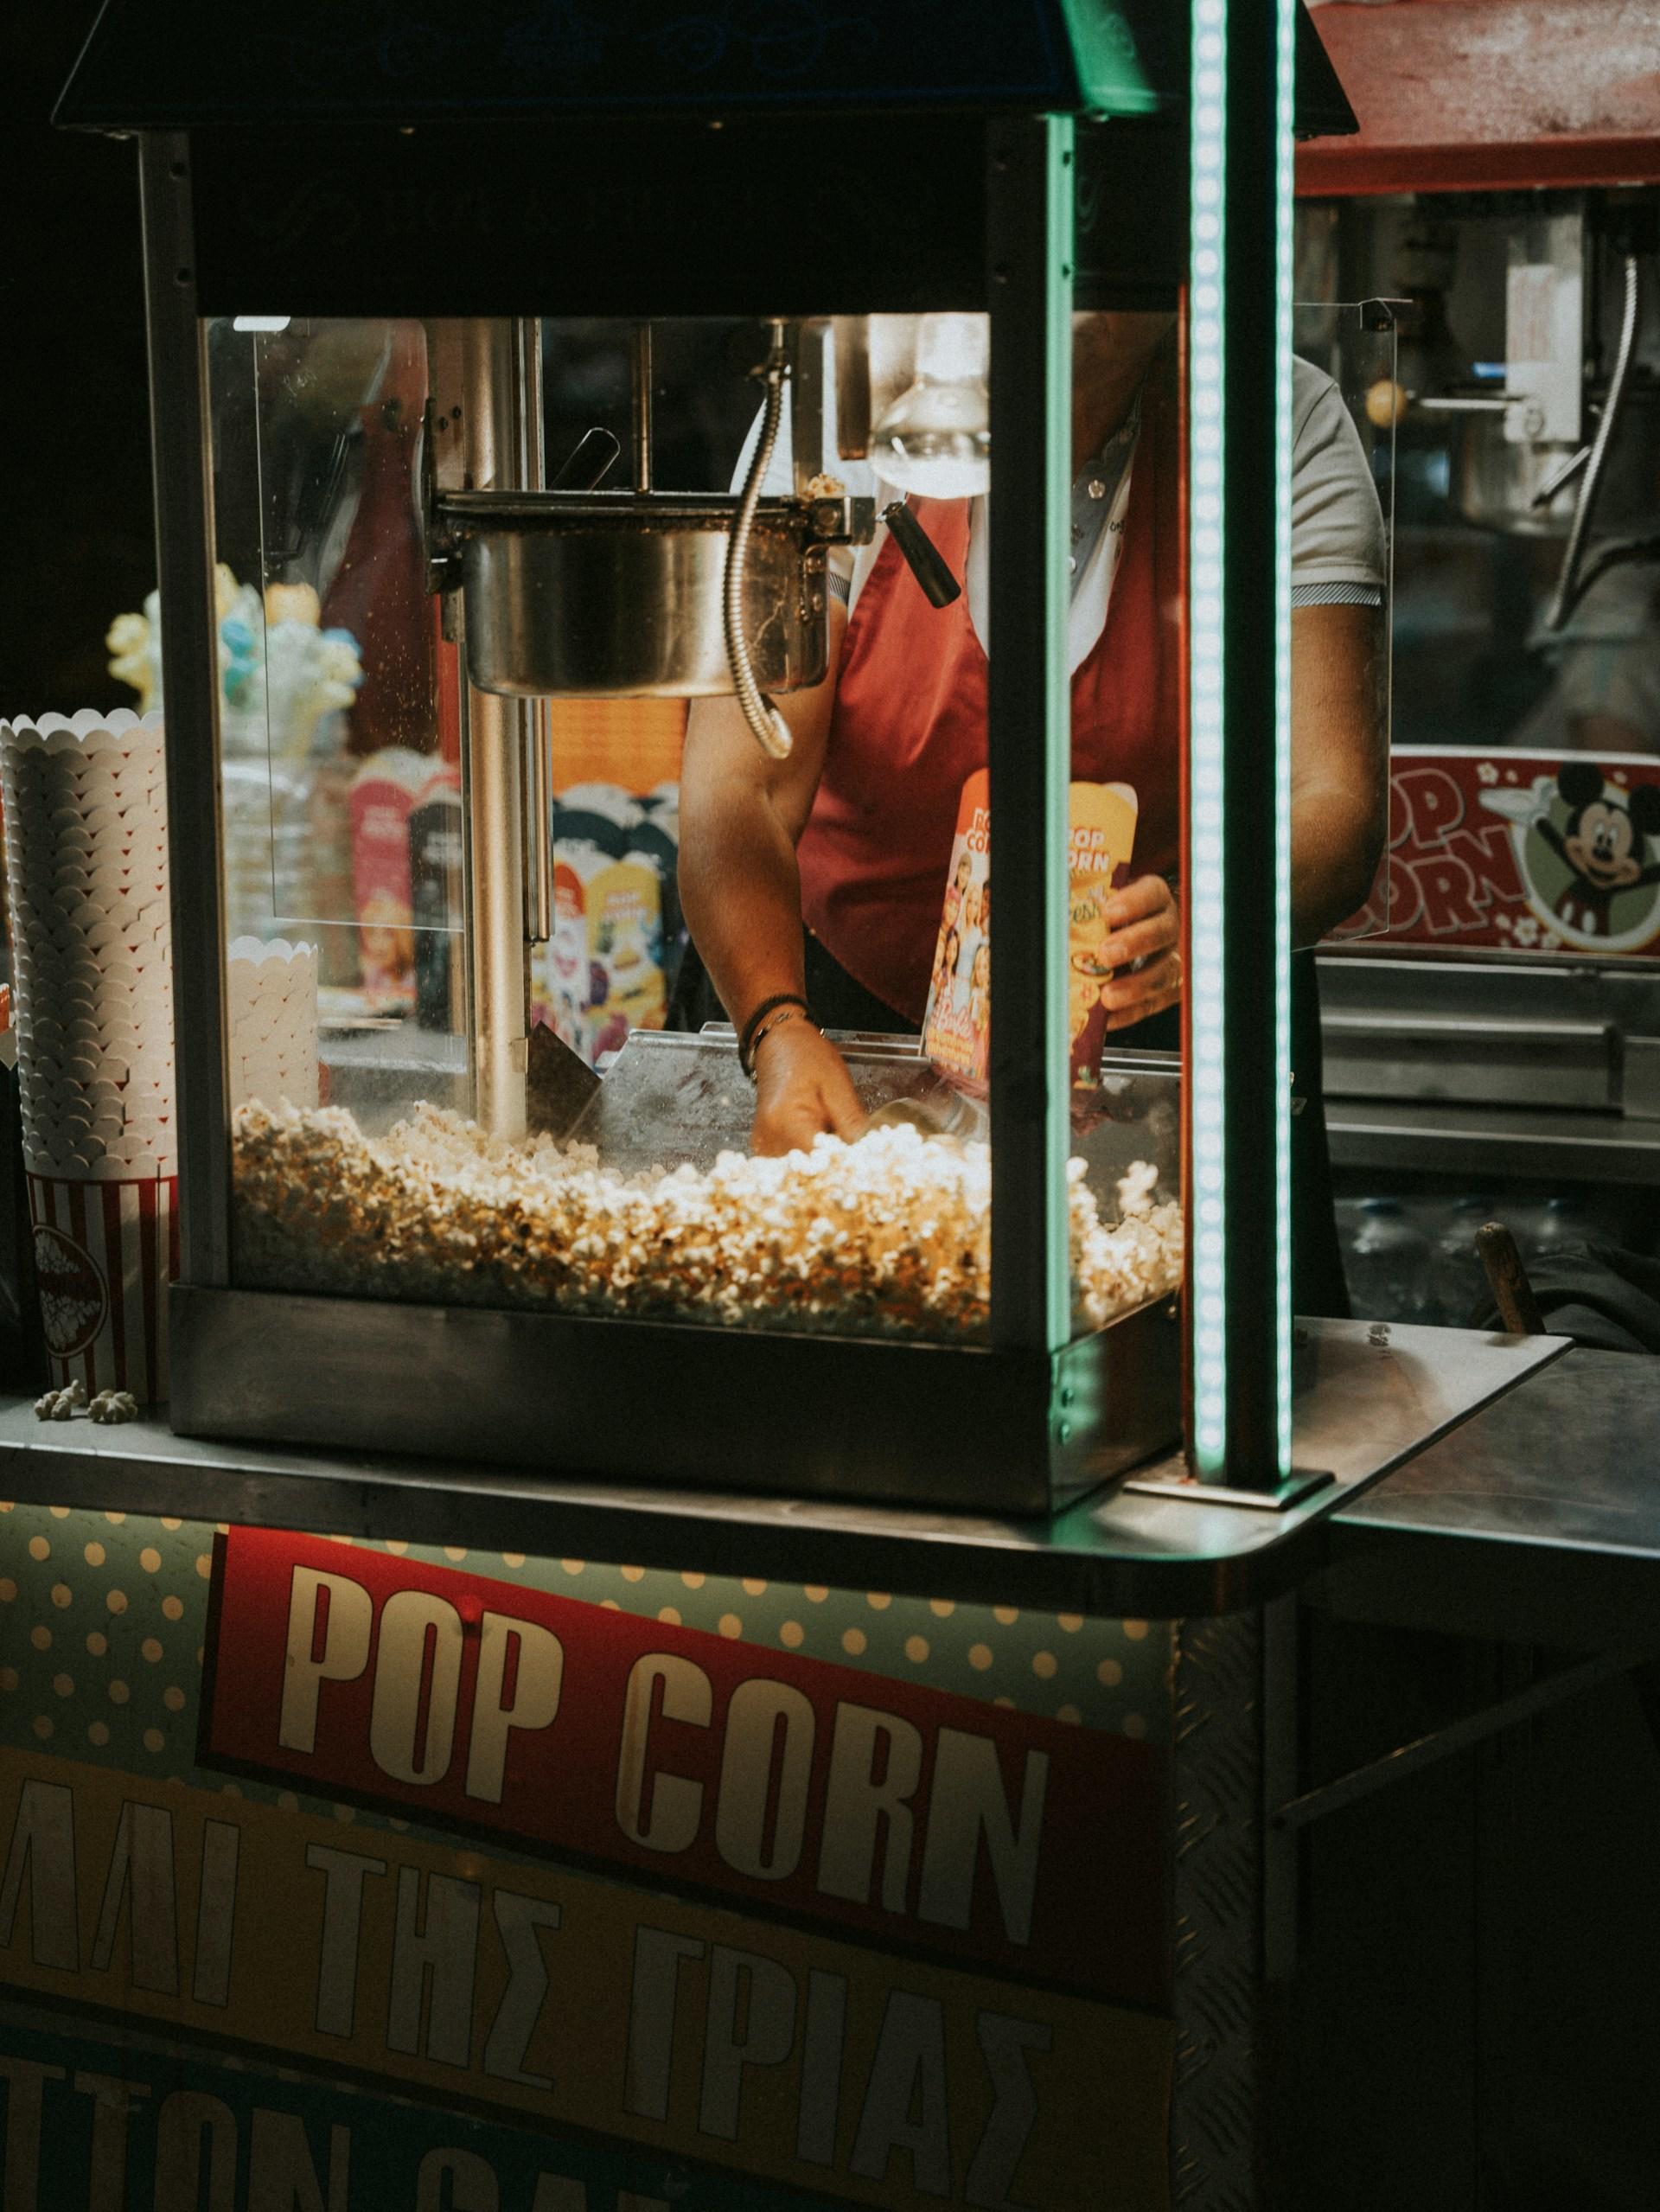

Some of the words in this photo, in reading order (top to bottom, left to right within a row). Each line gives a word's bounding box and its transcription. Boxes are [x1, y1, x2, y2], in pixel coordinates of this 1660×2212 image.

[1069, 828, 1106, 849] OP
[1334, 824, 1529, 936] ORN
[278, 1563, 565, 1805] POP
[614, 1652, 1052, 1947] CORN
[305, 1842, 563, 2094] ΤΗΣ
[622, 1923, 1054, 2212] ΓΡΙΑΣ
